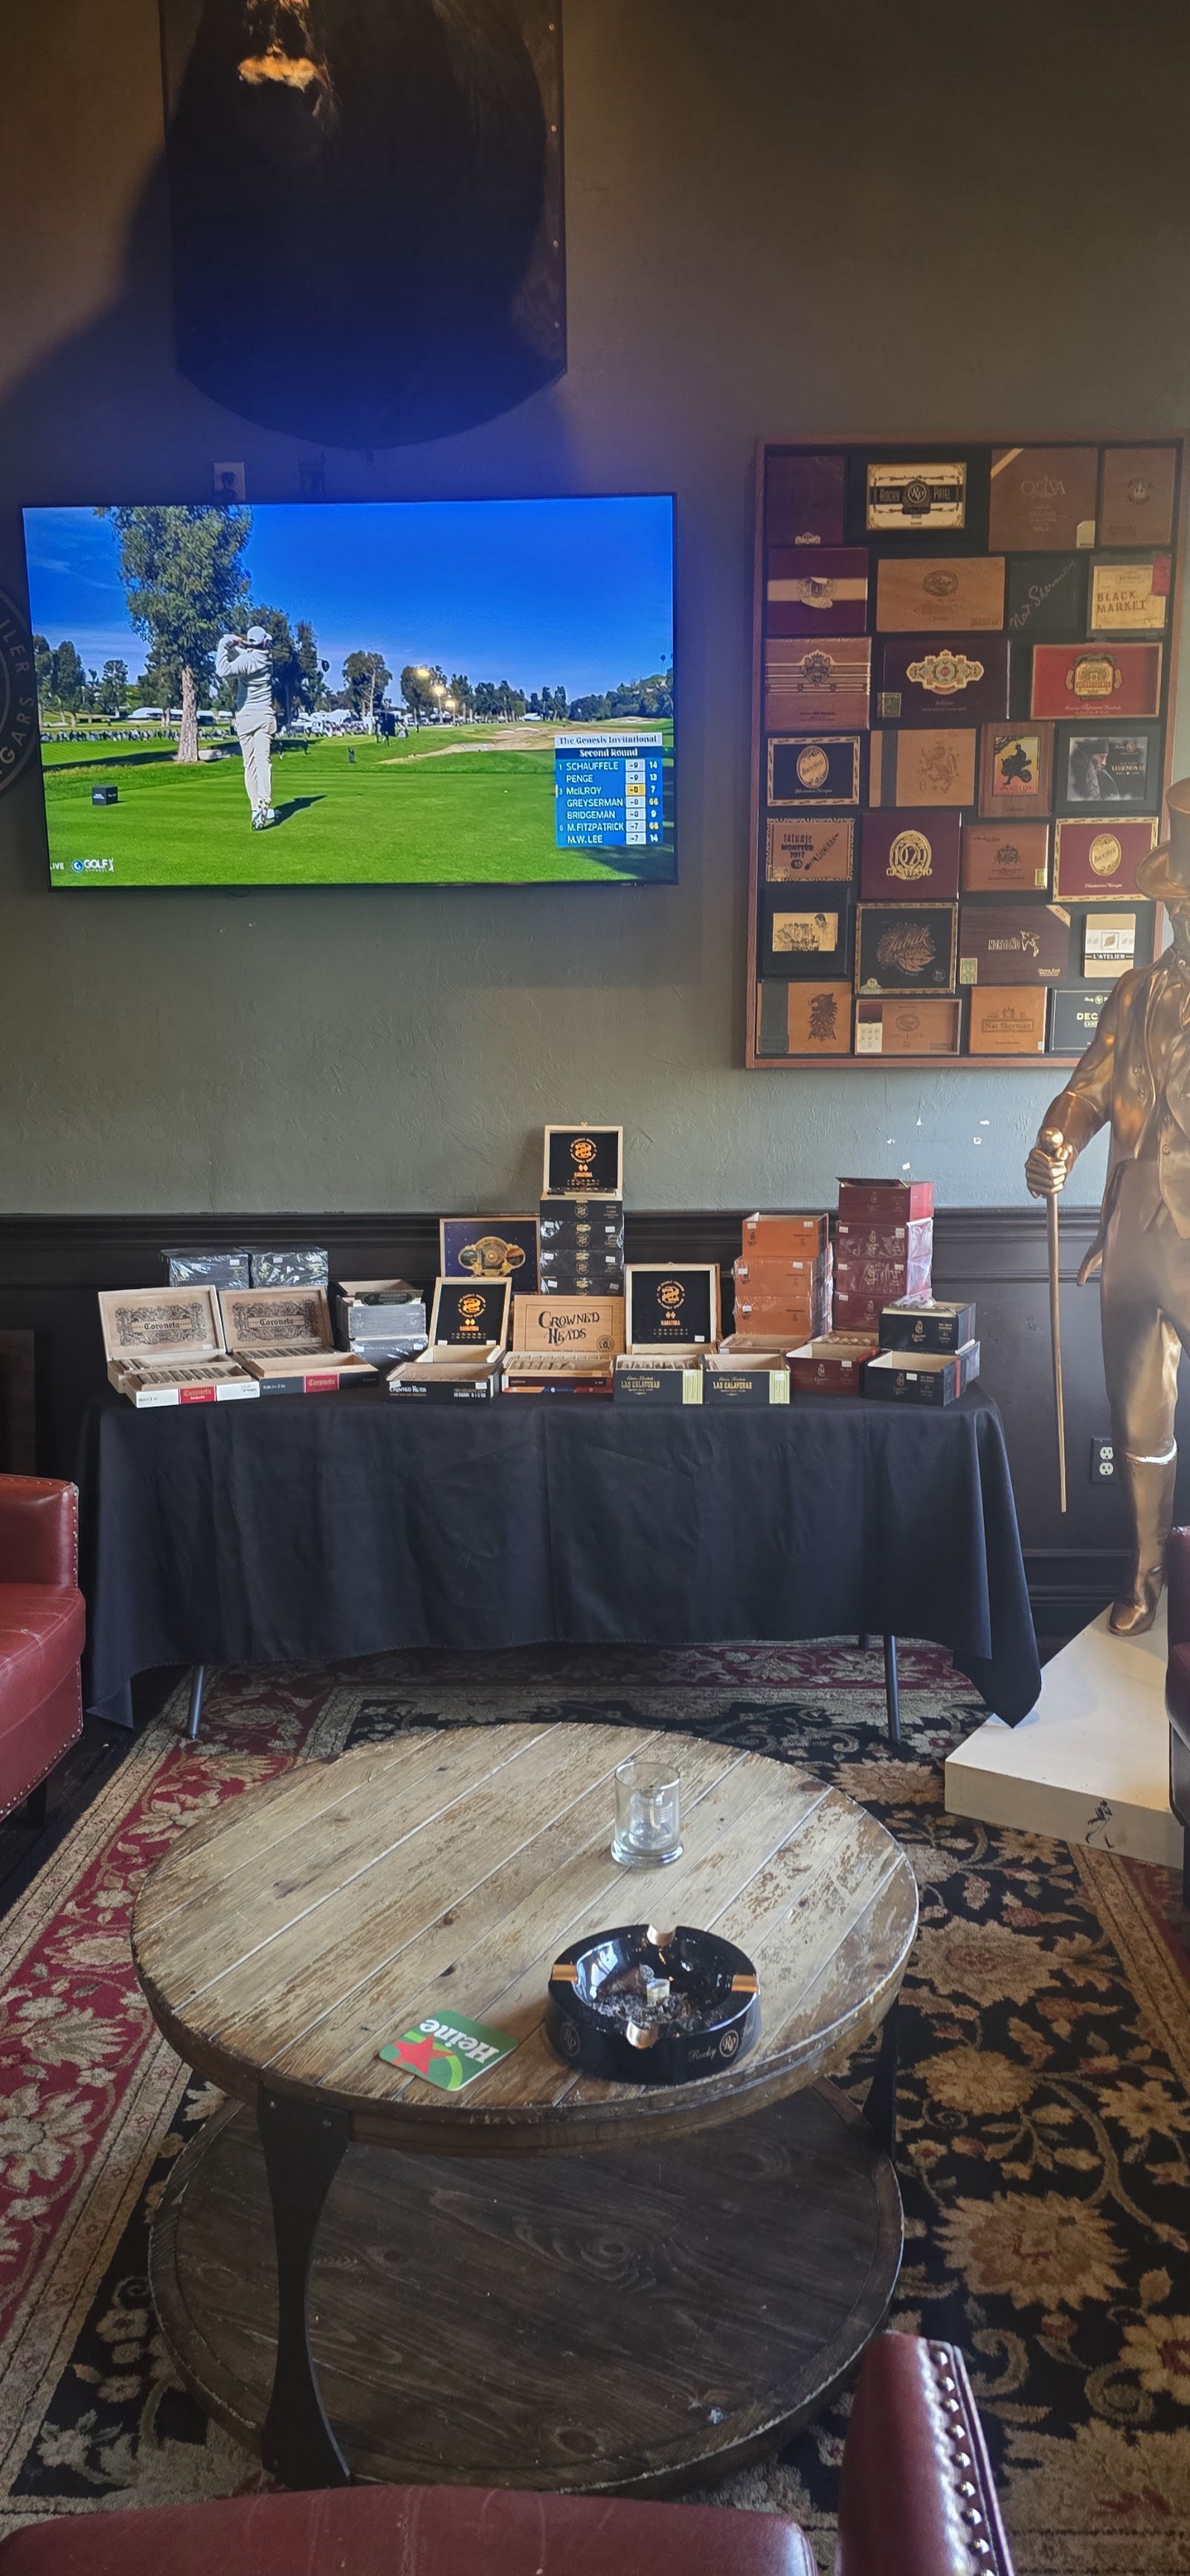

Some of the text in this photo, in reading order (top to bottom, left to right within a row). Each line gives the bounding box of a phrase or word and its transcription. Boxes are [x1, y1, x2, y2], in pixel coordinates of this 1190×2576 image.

[880, 488, 901, 503] ROCKY
[933, 487, 951, 501] PATEL
[1009, 603, 1032, 629] Nat
[1028, 559, 1078, 607] Sherman
[1097, 590, 1136, 603] BLACK
[1096, 600, 1146, 614] MARKET
[576, 736, 607, 745] Genesis
[608, 735, 657, 744] Invitational
[579, 748, 638, 757] Second Round
[566, 762, 619, 771] SCHAUFFELE
[649, 761, 657, 769] 14
[566, 774, 594, 783] PENGE
[566, 787, 602, 795] McILROY
[567, 799, 623, 807] GREYSERMAN
[567, 811, 615, 820] BRIDGEMAN
[83, 858, 108, 869] GOLF
[985, 1021, 1032, 1030] Nat Sherman
[260, 1317, 295, 1326] Coroneta
[538, 1311, 600, 1329] CROWNED
[144, 1322, 181, 1331] Coroneta
[544, 1328, 587, 1346] HEADS
[309, 1378, 335, 1387] Coroneta
[621, 1381, 660, 1389] LAS CALAVERAS
[713, 1381, 753, 1390] LAS CALAVERAS
[183, 1388, 212, 1396] Coroneta
[419, 2019, 500, 2063] Heine
[688, 2047, 716, 2062] Rocky
